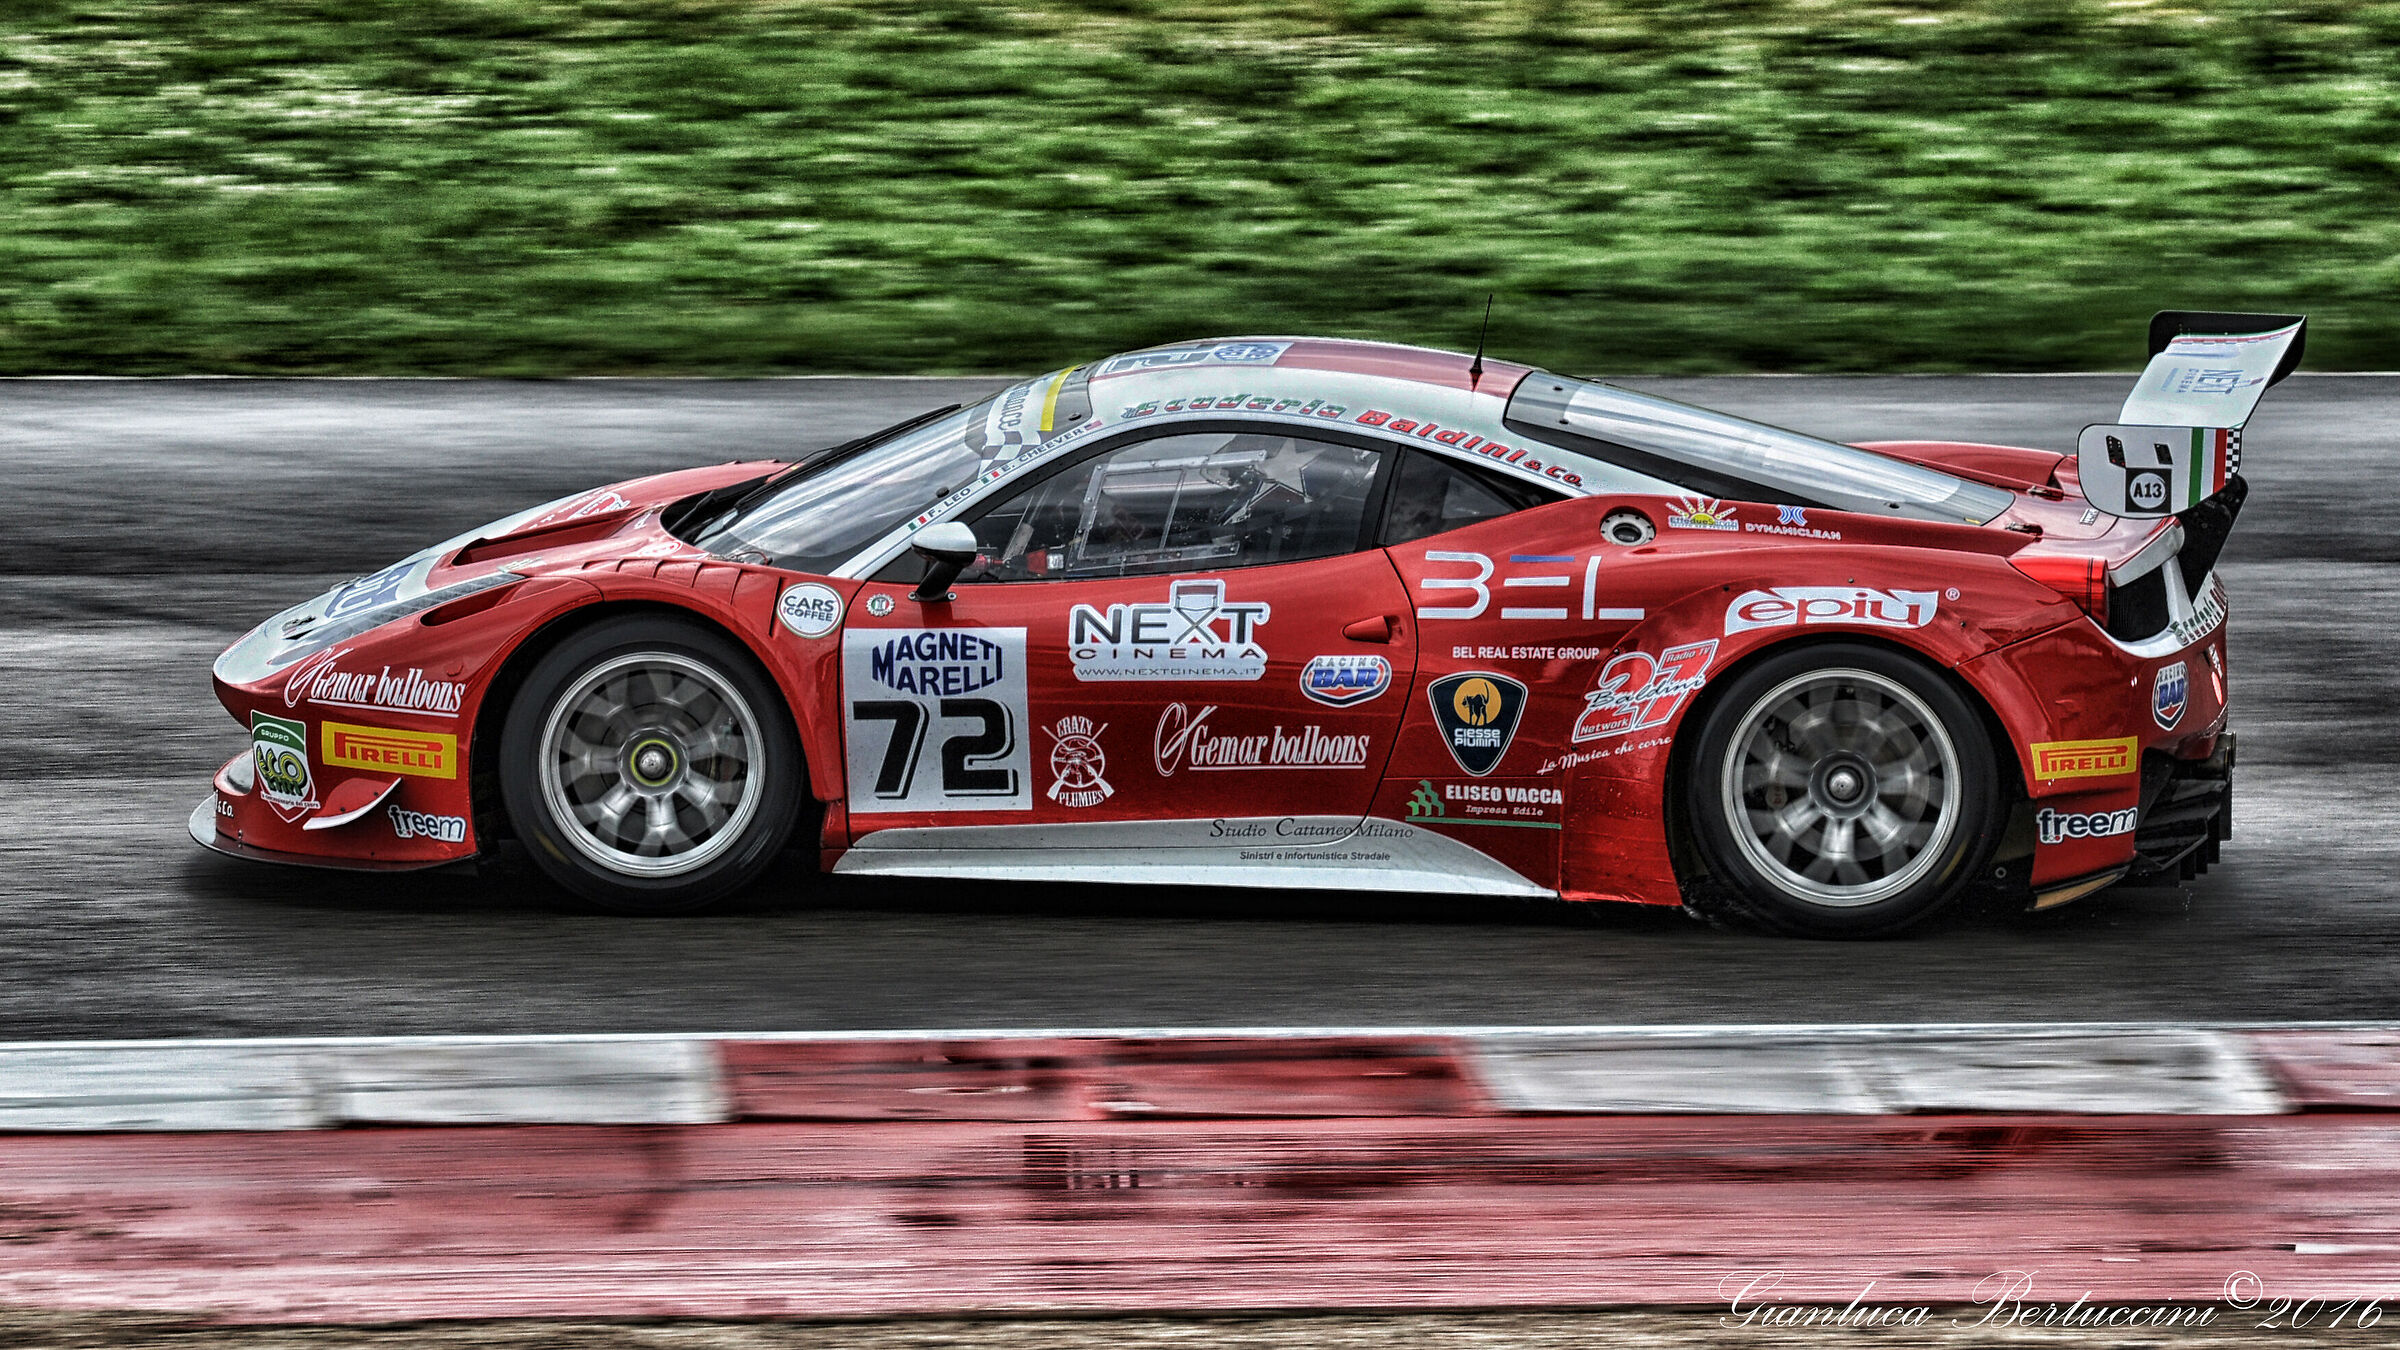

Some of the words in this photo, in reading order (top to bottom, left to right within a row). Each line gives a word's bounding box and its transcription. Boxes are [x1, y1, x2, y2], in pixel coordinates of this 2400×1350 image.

[1121, 393, 1347, 419] Scuderia
[1017, 427, 1084, 463] CHEEVER
[944, 487, 972, 508] LEO
[2133, 484, 2163, 499] A13
[1745, 522, 1842, 541] DYNAMICLEAN
[1417, 550, 1645, 621] BEL
[784, 595, 835, 613] CARS
[786, 606, 834, 622] COFFEE
[1074, 604, 1264, 645] NEXT
[872, 632, 1003, 668] MAGNETI
[1075, 648, 1261, 660] CINEMA
[1452, 646, 1476, 659] BEL
[1477, 646, 1510, 660] REAL
[1511, 646, 1556, 660] ESTATE
[1556, 647, 1600, 660] GROUP
[1315, 657, 1379, 667] RACING
[310, 661, 377, 704] Gemar
[373, 665, 466, 713] balloons
[872, 658, 1003, 696] MARELLI
[1311, 669, 1379, 688] BAR
[1586, 675, 1705, 708] Baldini
[261, 729, 290, 742] GRUPPO
[1056, 714, 1094, 738] CRAZY
[1580, 717, 1630, 735] Network
[333, 731, 444, 770] PIRELLI
[852, 698, 1020, 801] 72
[1190, 725, 1269, 766] Gemar
[1269, 725, 1370, 764] balloons
[1536, 758, 1558, 775] La
[1558, 749, 1611, 770] Musica
[1614, 741, 1635, 756] che
[1638, 736, 1672, 749] corre
[2039, 744, 2129, 773] PIRELLI
[1058, 790, 1105, 808] PLUMIES
[1445, 784, 1502, 801] ELISEO
[1504, 787, 1563, 805] VACCA
[1465, 804, 1509, 815] Impresa
[1512, 806, 1545, 816] Edile
[390, 806, 466, 839] freem
[1209, 818, 1267, 838] Studio
[1275, 817, 1353, 838] Cattaneo
[1353, 823, 1415, 839] Milano
[2039, 807, 2137, 837] freem
[1239, 850, 1274, 861] Sinistri
[1275, 852, 1283, 861] e
[1284, 851, 1348, 861] Infortunistica
[1350, 851, 1391, 861] Stradale
